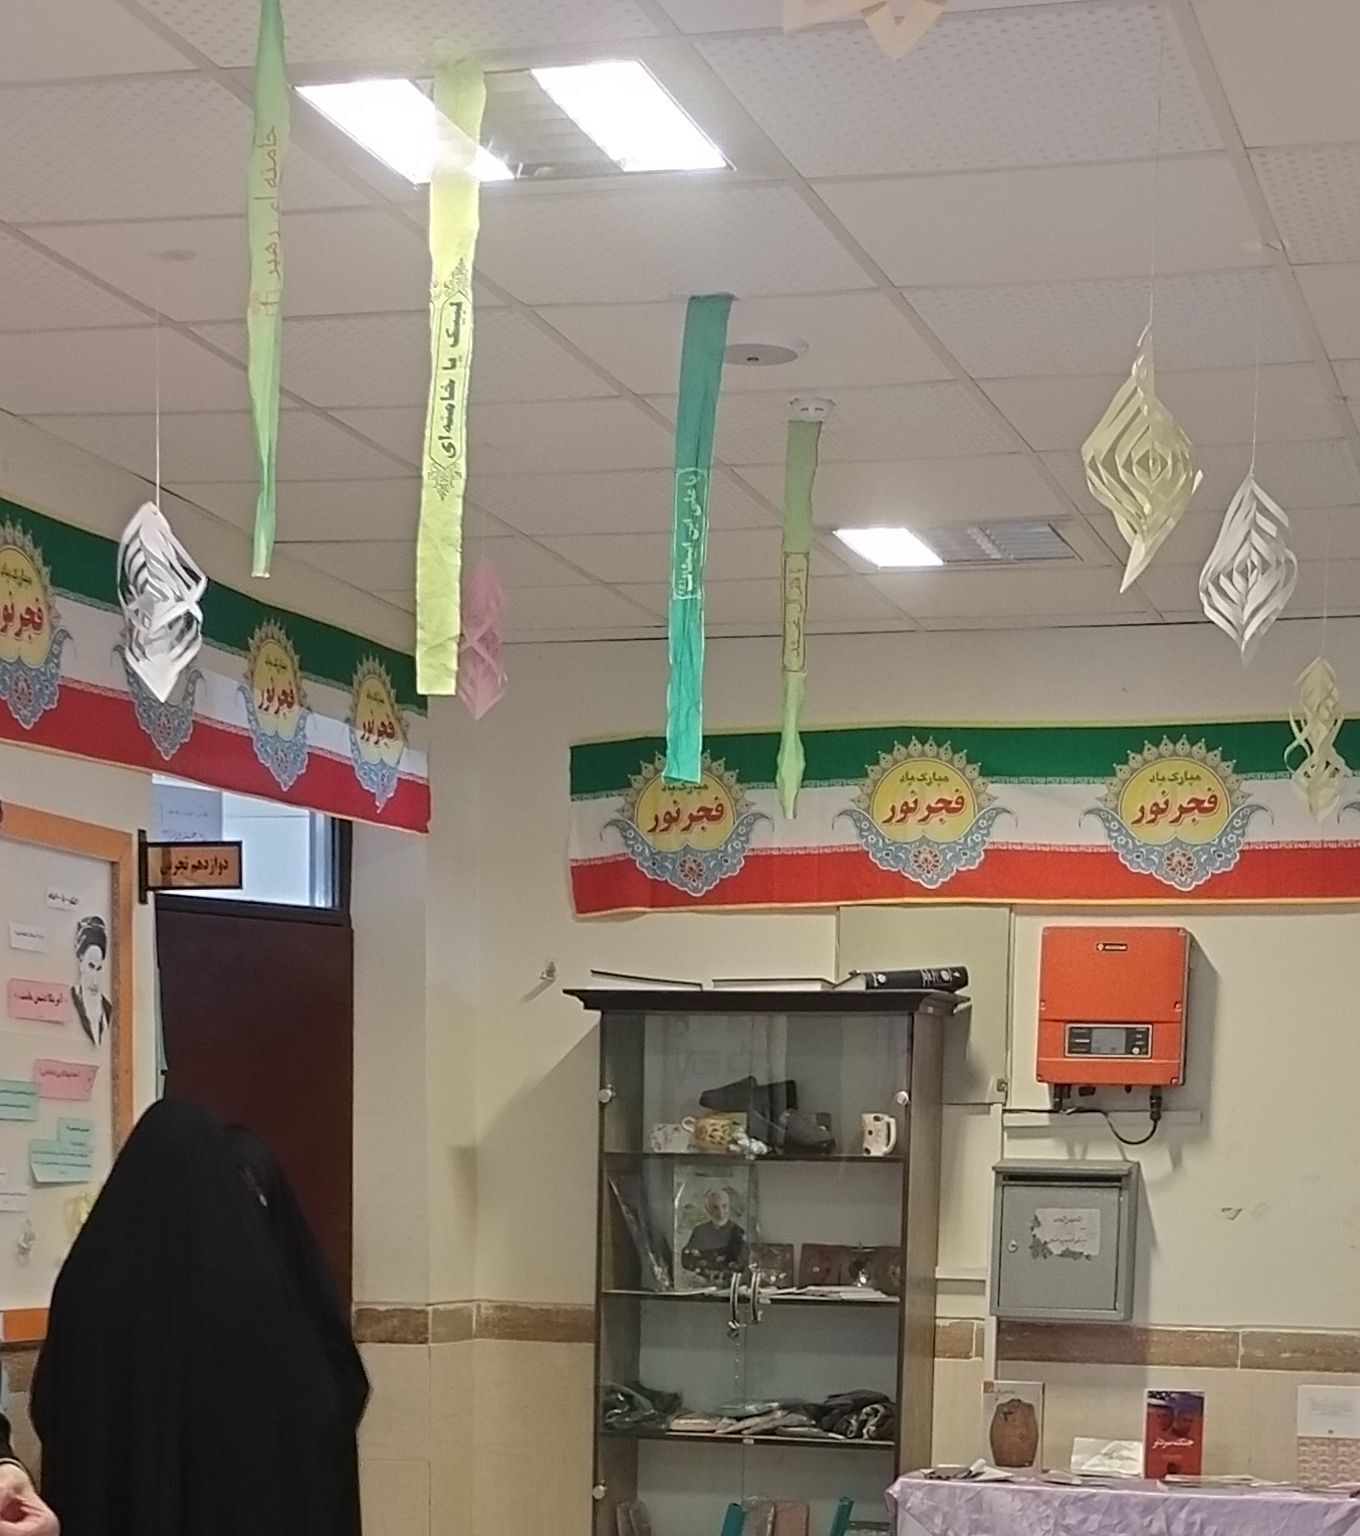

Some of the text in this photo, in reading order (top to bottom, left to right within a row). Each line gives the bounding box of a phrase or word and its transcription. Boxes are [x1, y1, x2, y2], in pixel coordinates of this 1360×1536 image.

[445, 301, 467, 348] لبیک
[442, 354, 462, 370] یا
[14, 597, 44, 641] فجر
[647, 796, 725, 833] فجر نور
[881, 788, 965, 823] فجر نور
[1130, 786, 1218, 825] فجر نور
